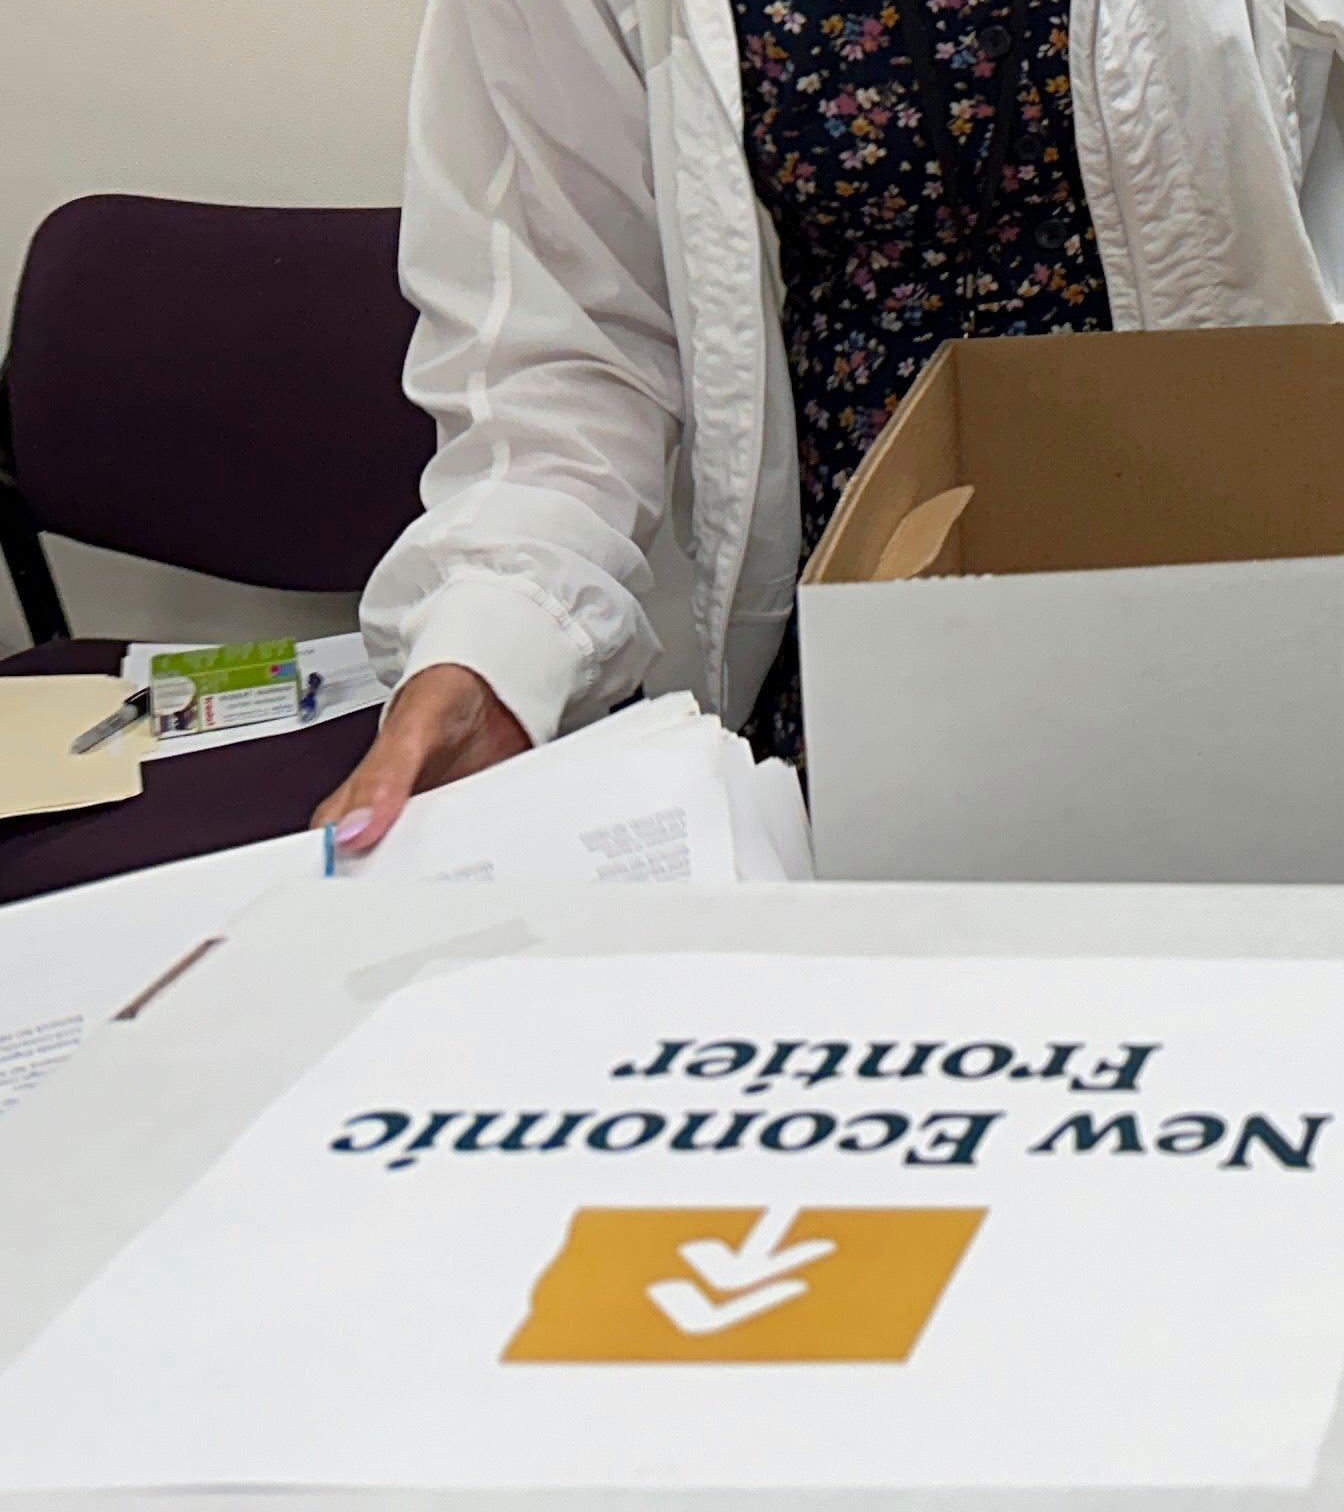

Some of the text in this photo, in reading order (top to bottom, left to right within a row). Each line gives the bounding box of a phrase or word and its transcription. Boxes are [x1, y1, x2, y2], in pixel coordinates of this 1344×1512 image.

[610, 1039, 1161, 1094] Frontier
[330, 1109, 1332, 1171] New Economic
